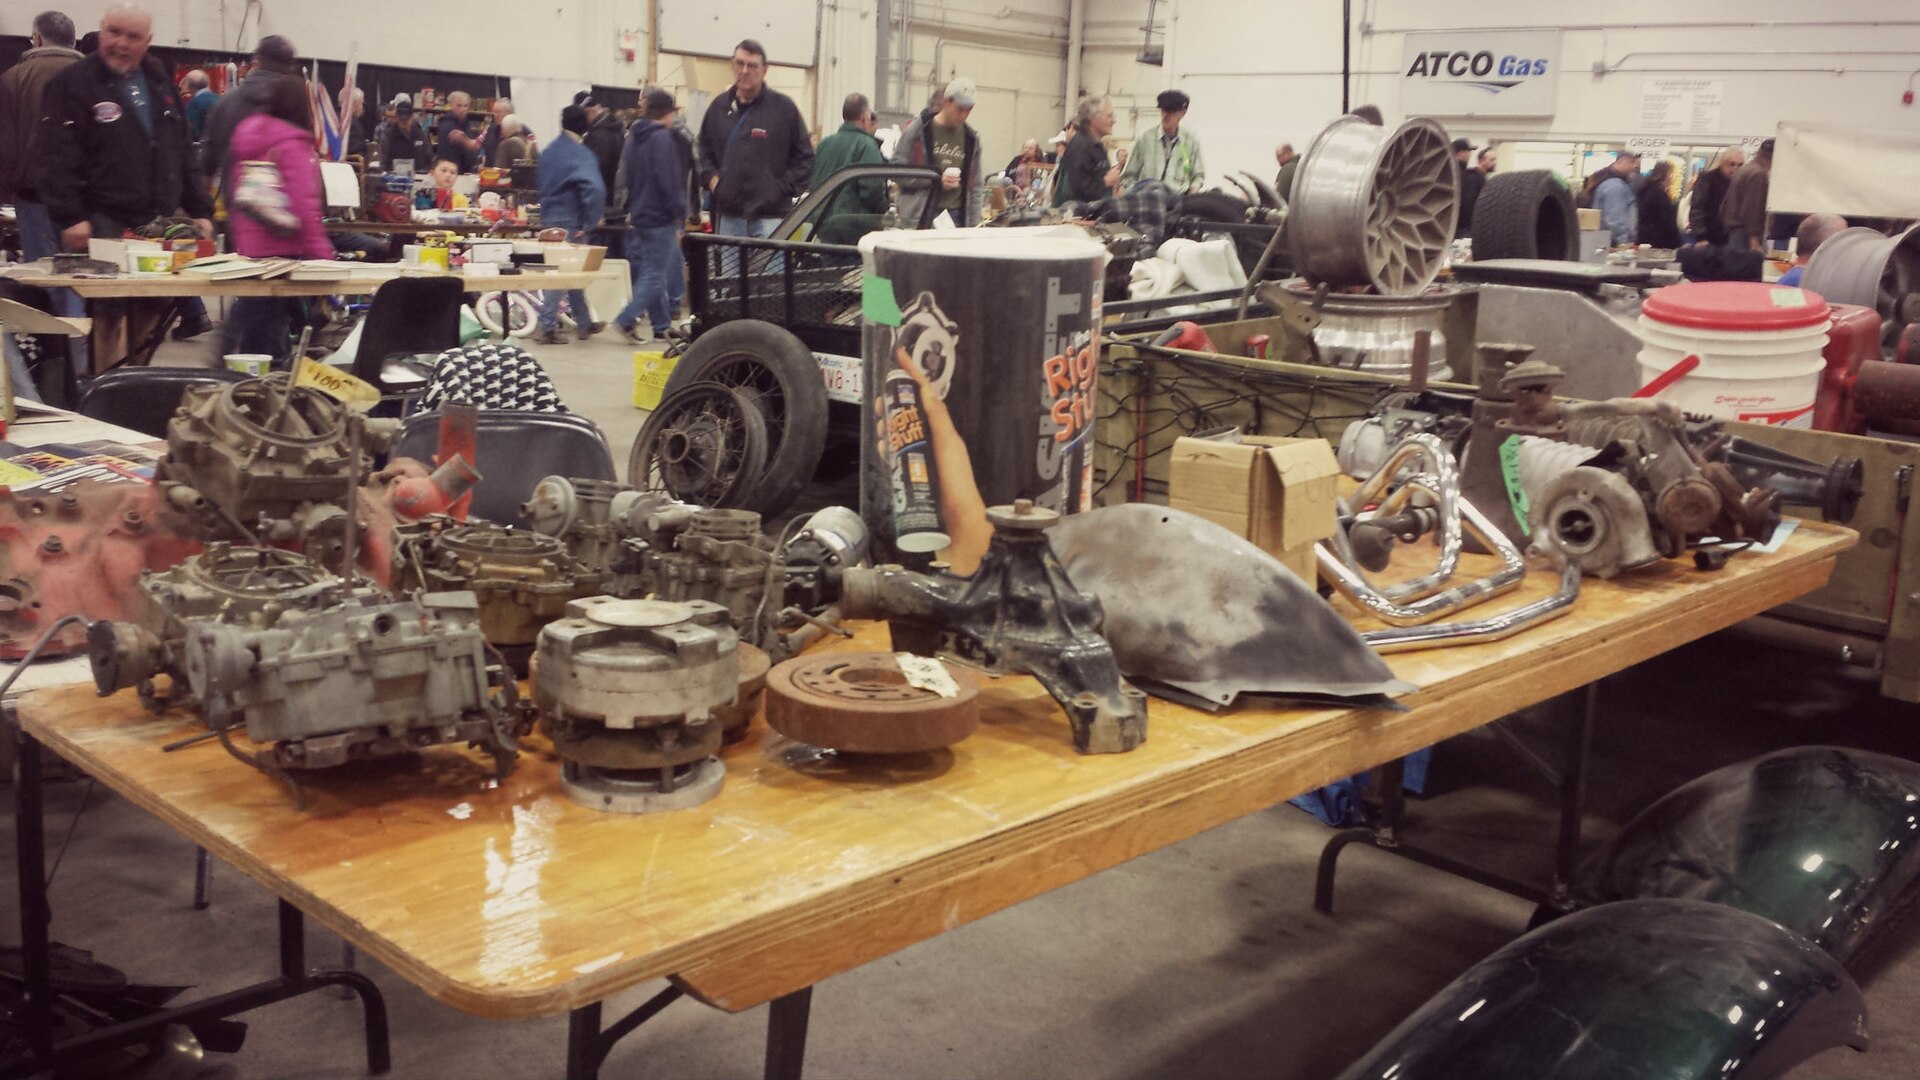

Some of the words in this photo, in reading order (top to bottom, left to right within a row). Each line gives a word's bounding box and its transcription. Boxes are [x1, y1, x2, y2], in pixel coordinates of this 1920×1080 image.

[1406, 50, 1494, 77] ATCO
[1498, 55, 1548, 76] Gas
[1629, 138, 1668, 147] ORDER
[1051, 386, 1096, 442] Stu
